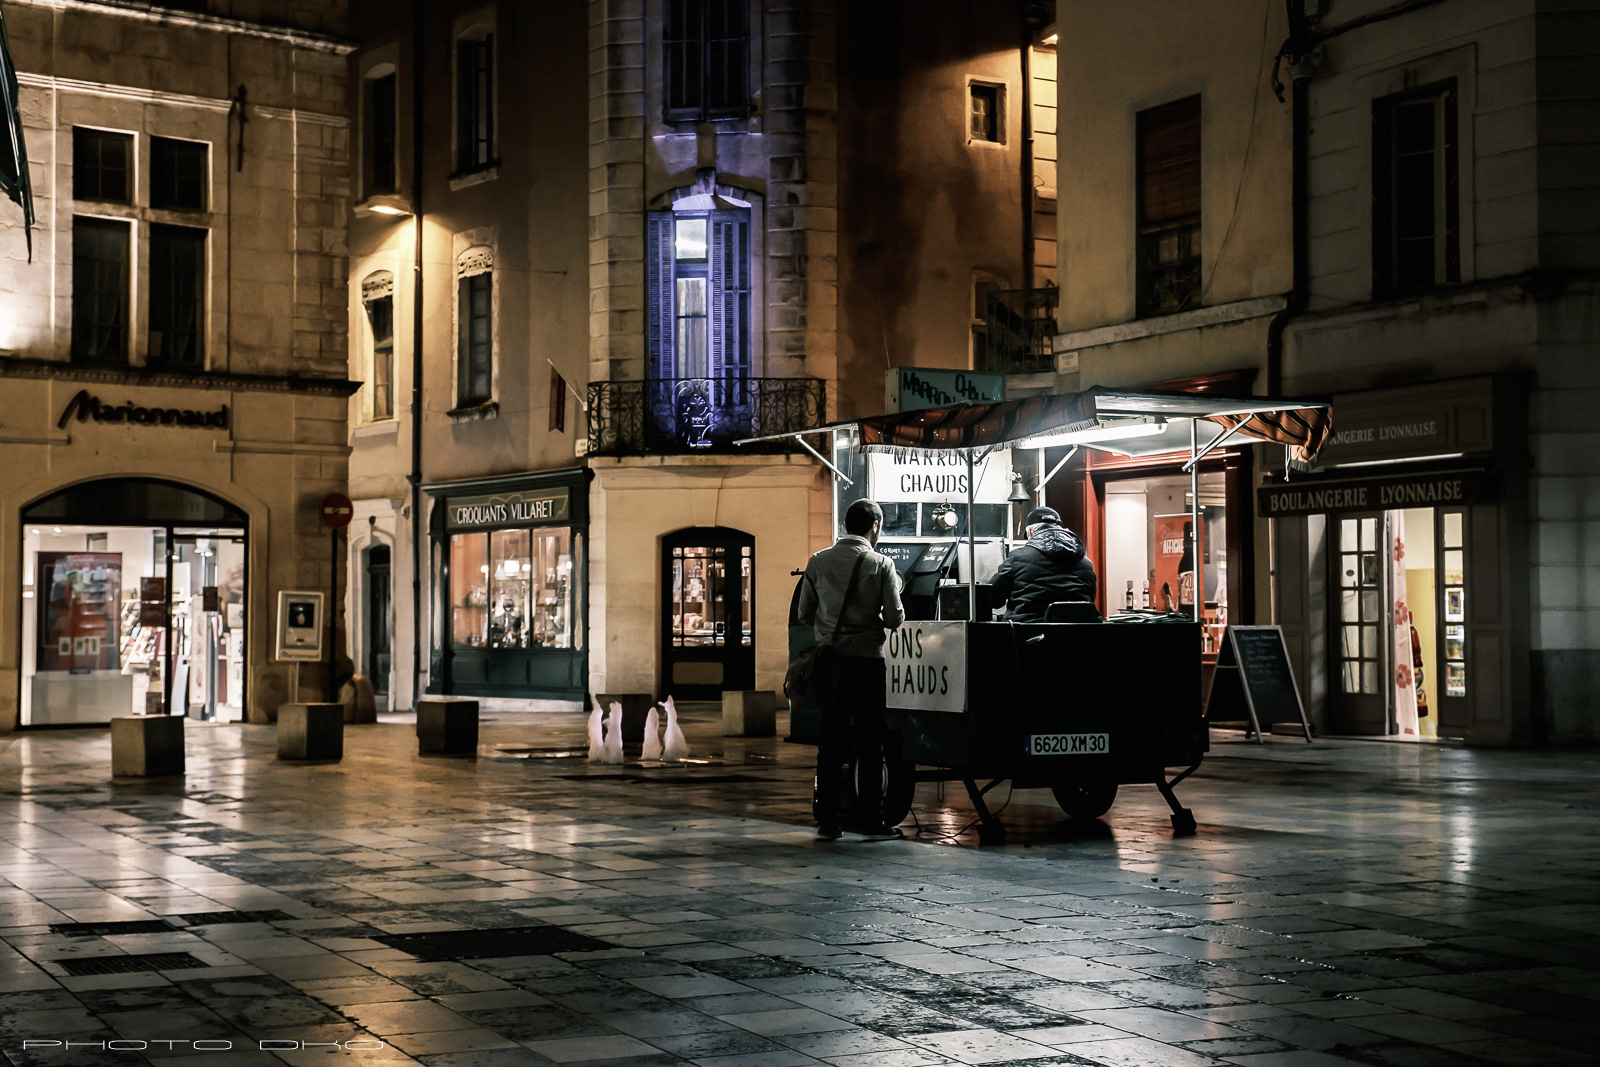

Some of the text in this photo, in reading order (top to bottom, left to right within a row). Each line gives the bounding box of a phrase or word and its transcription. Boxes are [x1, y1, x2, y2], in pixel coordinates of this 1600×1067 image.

[57, 389, 229, 430] Marionnaud
[1329, 421, 1437, 446] ANGERIE LYONNAISE
[900, 474, 968, 493] CHAUDS
[1270, 480, 1463, 512] BOULANGERIE LYONNAISE
[457, 499, 553, 525] CROQUANTS VILLARET
[889, 627, 923, 659] ONS
[891, 664, 949, 695] HAUDS
